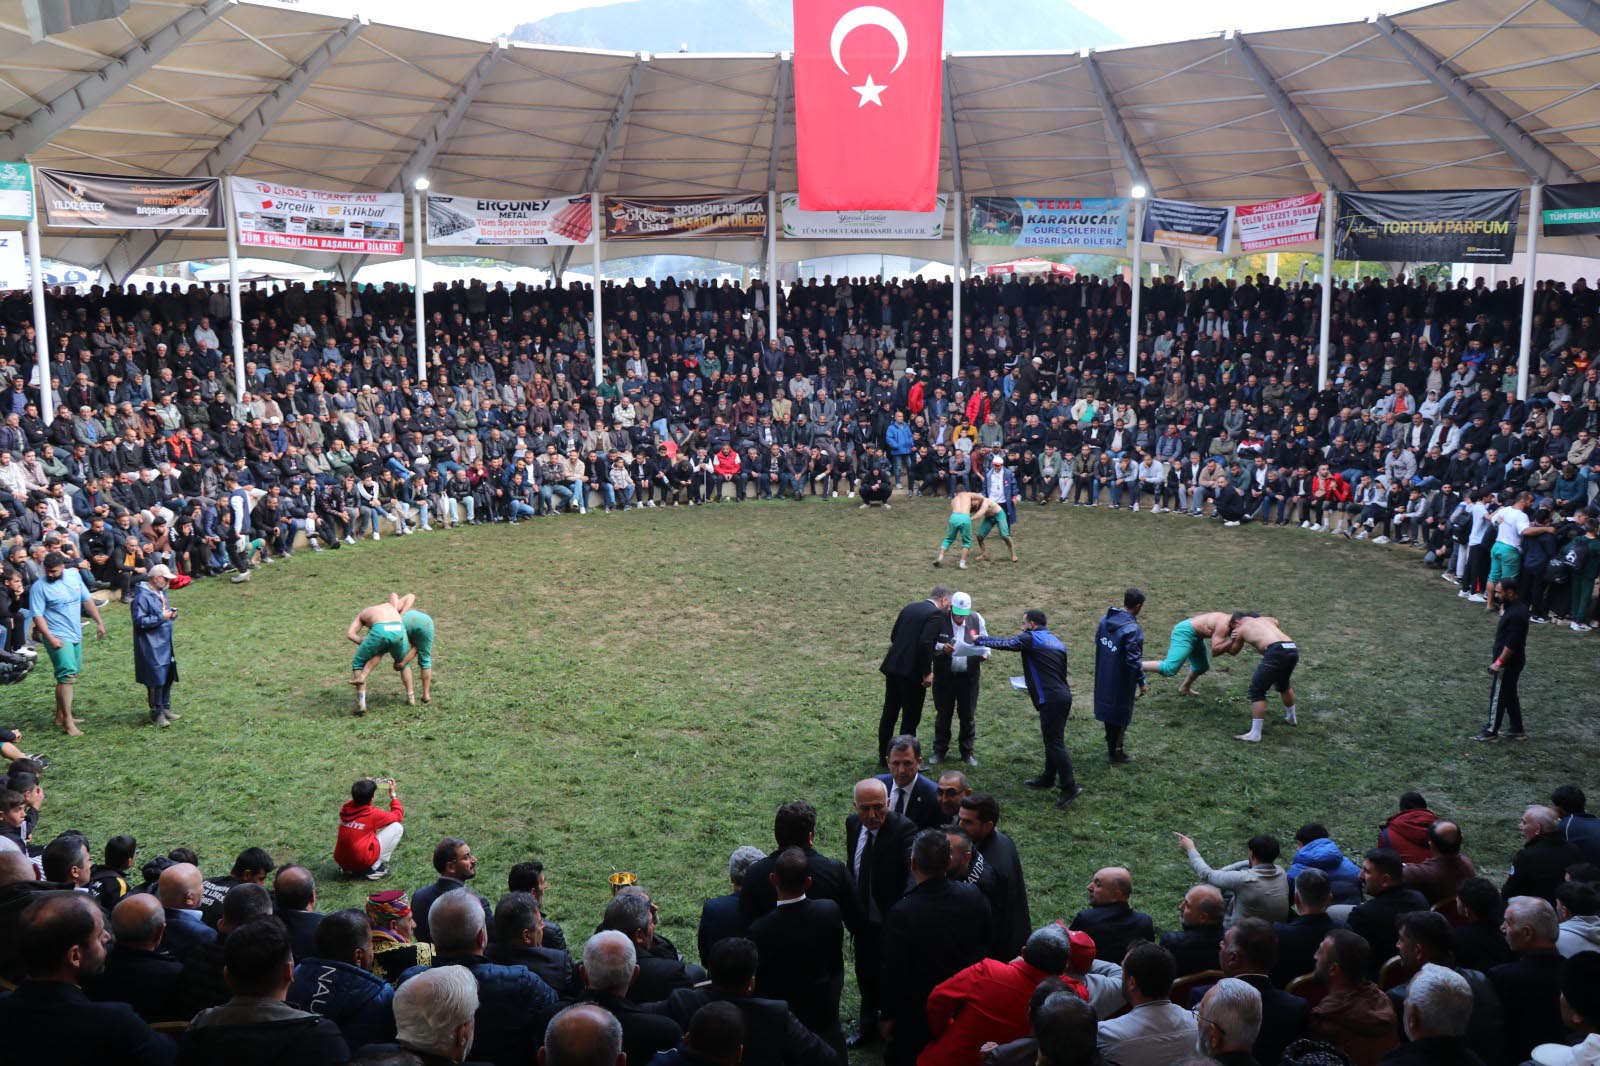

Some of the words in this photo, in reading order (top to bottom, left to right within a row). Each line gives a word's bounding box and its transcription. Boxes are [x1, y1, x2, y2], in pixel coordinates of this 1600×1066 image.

[80, 202, 105, 211] PETEK
[275, 200, 316, 214] arçelik
[673, 202, 764, 217] SPORCULARIMIZA
[1036, 199, 1084, 210] TEMA
[136, 206, 177, 216] BAŞARILAR
[342, 206, 386, 217] istikbal
[1266, 210, 1290, 221] LEZZET
[1549, 211, 1567, 221] TÜM
[477, 218, 497, 227] Tüm
[498, 218, 547, 228] Sporculara
[673, 214, 730, 231] BAŞARILAR
[1026, 214, 1121, 225] KARAKUCAK
[523, 228, 545, 236] Diler
[1381, 220, 1443, 235] TORTUM
[1445, 220, 1509, 235] PARFUM
[241, 231, 260, 245] TÜM
[321, 240, 365, 251] BAŞARILAR
